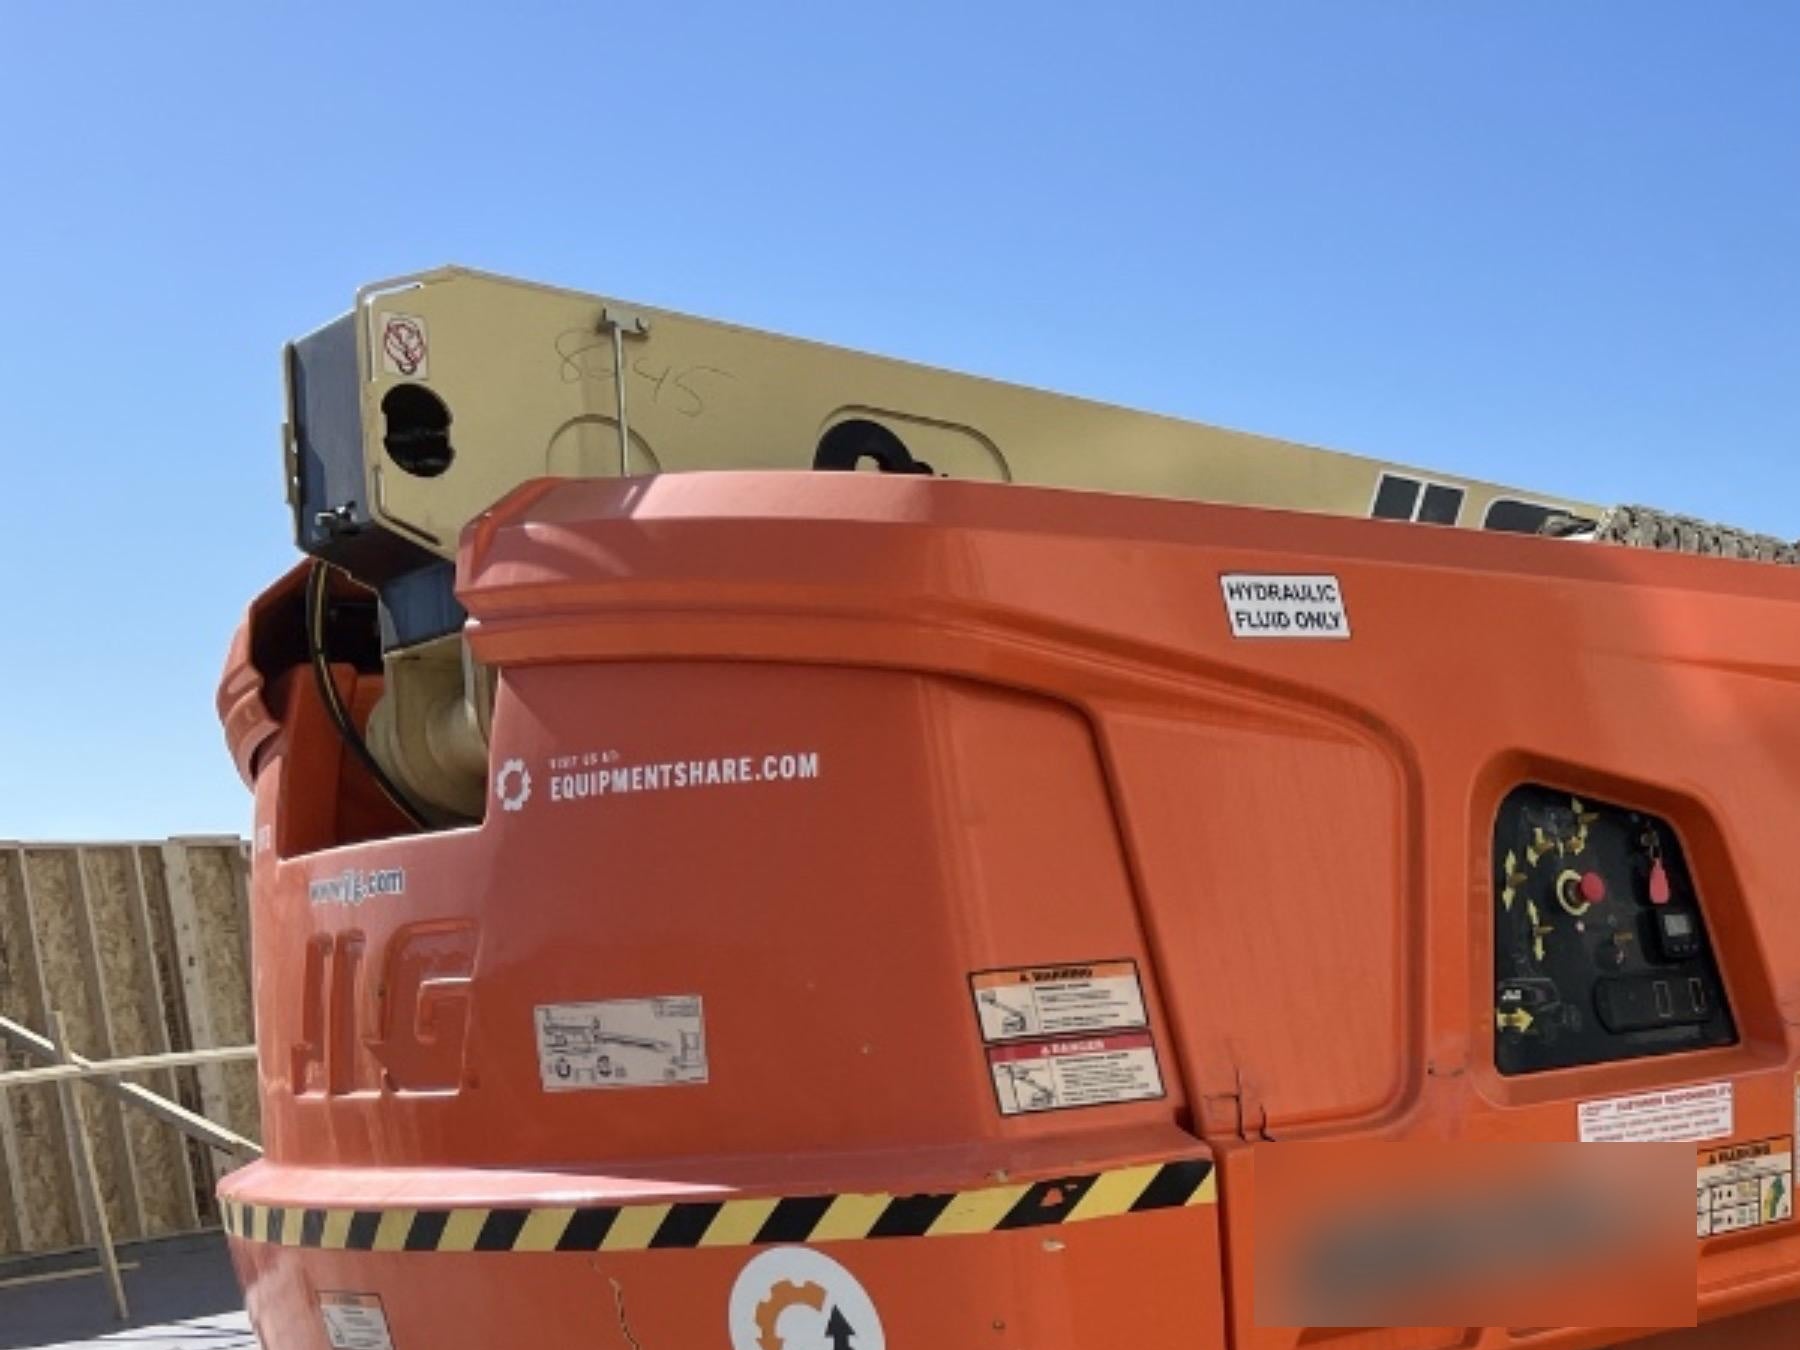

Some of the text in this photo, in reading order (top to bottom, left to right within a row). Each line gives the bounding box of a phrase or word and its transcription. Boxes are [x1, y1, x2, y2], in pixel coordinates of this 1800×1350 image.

[1226, 580, 1337, 602] HYDRAULIC
[1235, 610, 1341, 630] FLUID ONLY
[550, 753, 819, 801] EQUIPMENTSHARE.COM
[291, 919, 483, 1099] JLG
